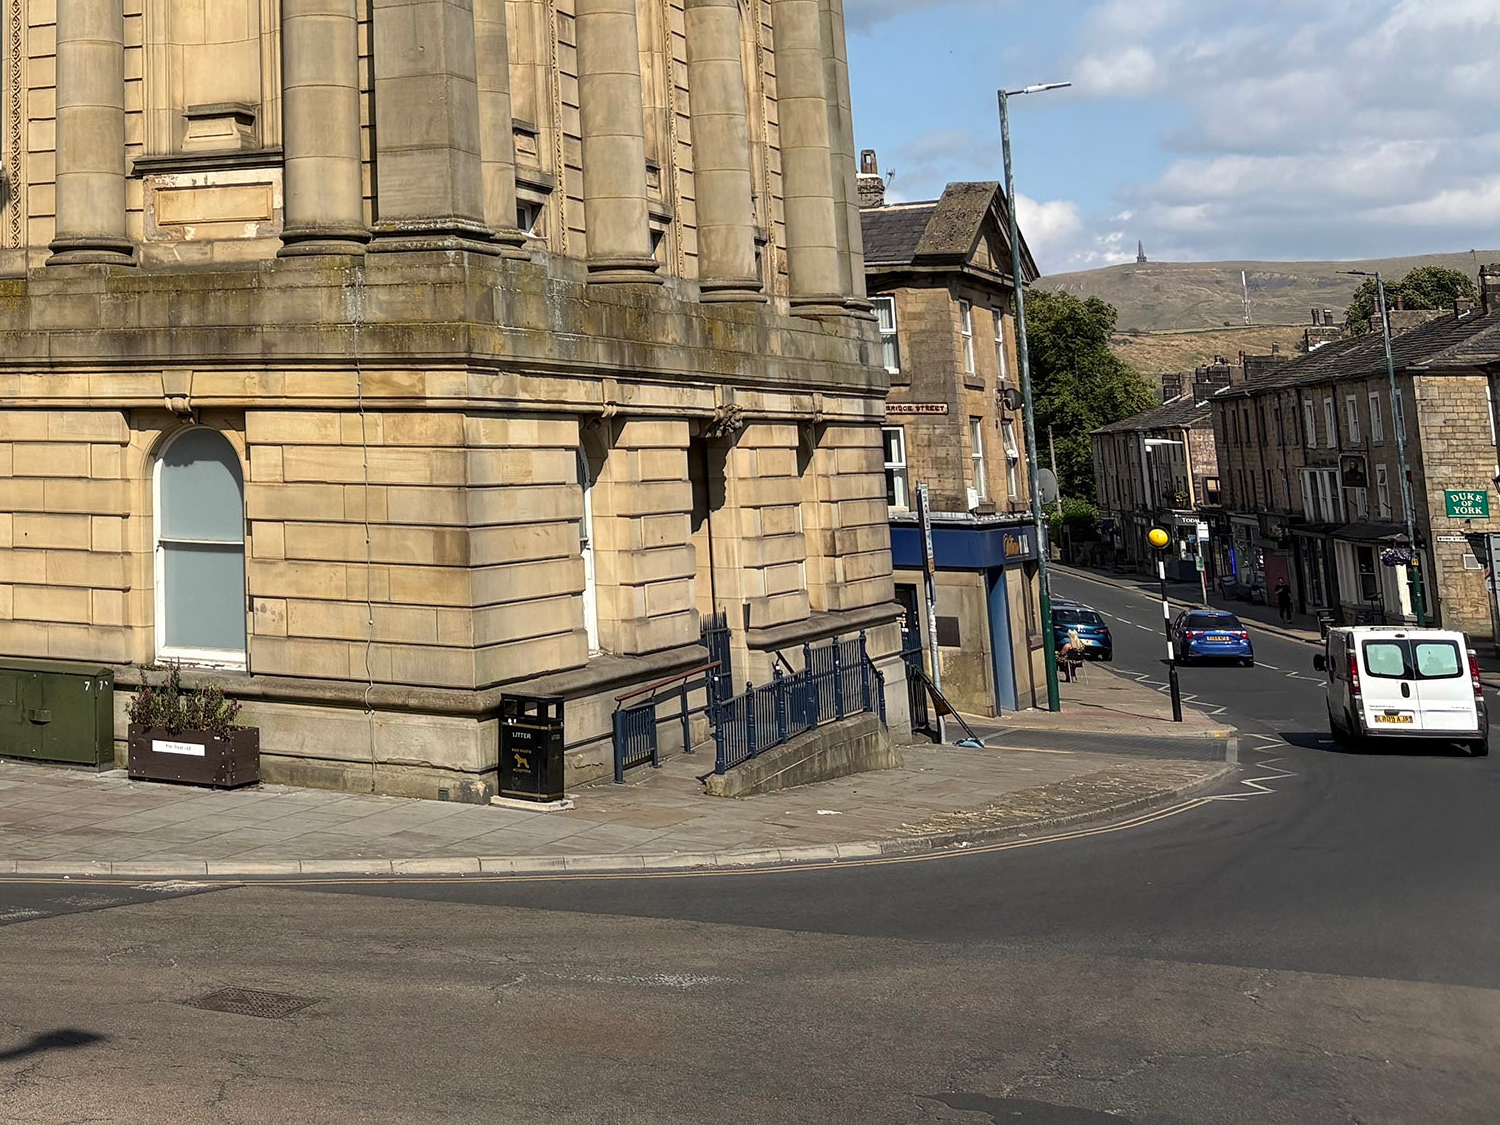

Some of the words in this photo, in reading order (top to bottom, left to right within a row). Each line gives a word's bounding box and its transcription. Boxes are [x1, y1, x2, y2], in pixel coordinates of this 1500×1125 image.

[1450, 492, 1483, 503] DUKE
[1453, 506, 1483, 515] YORK
[512, 732, 532, 740] LITTER
